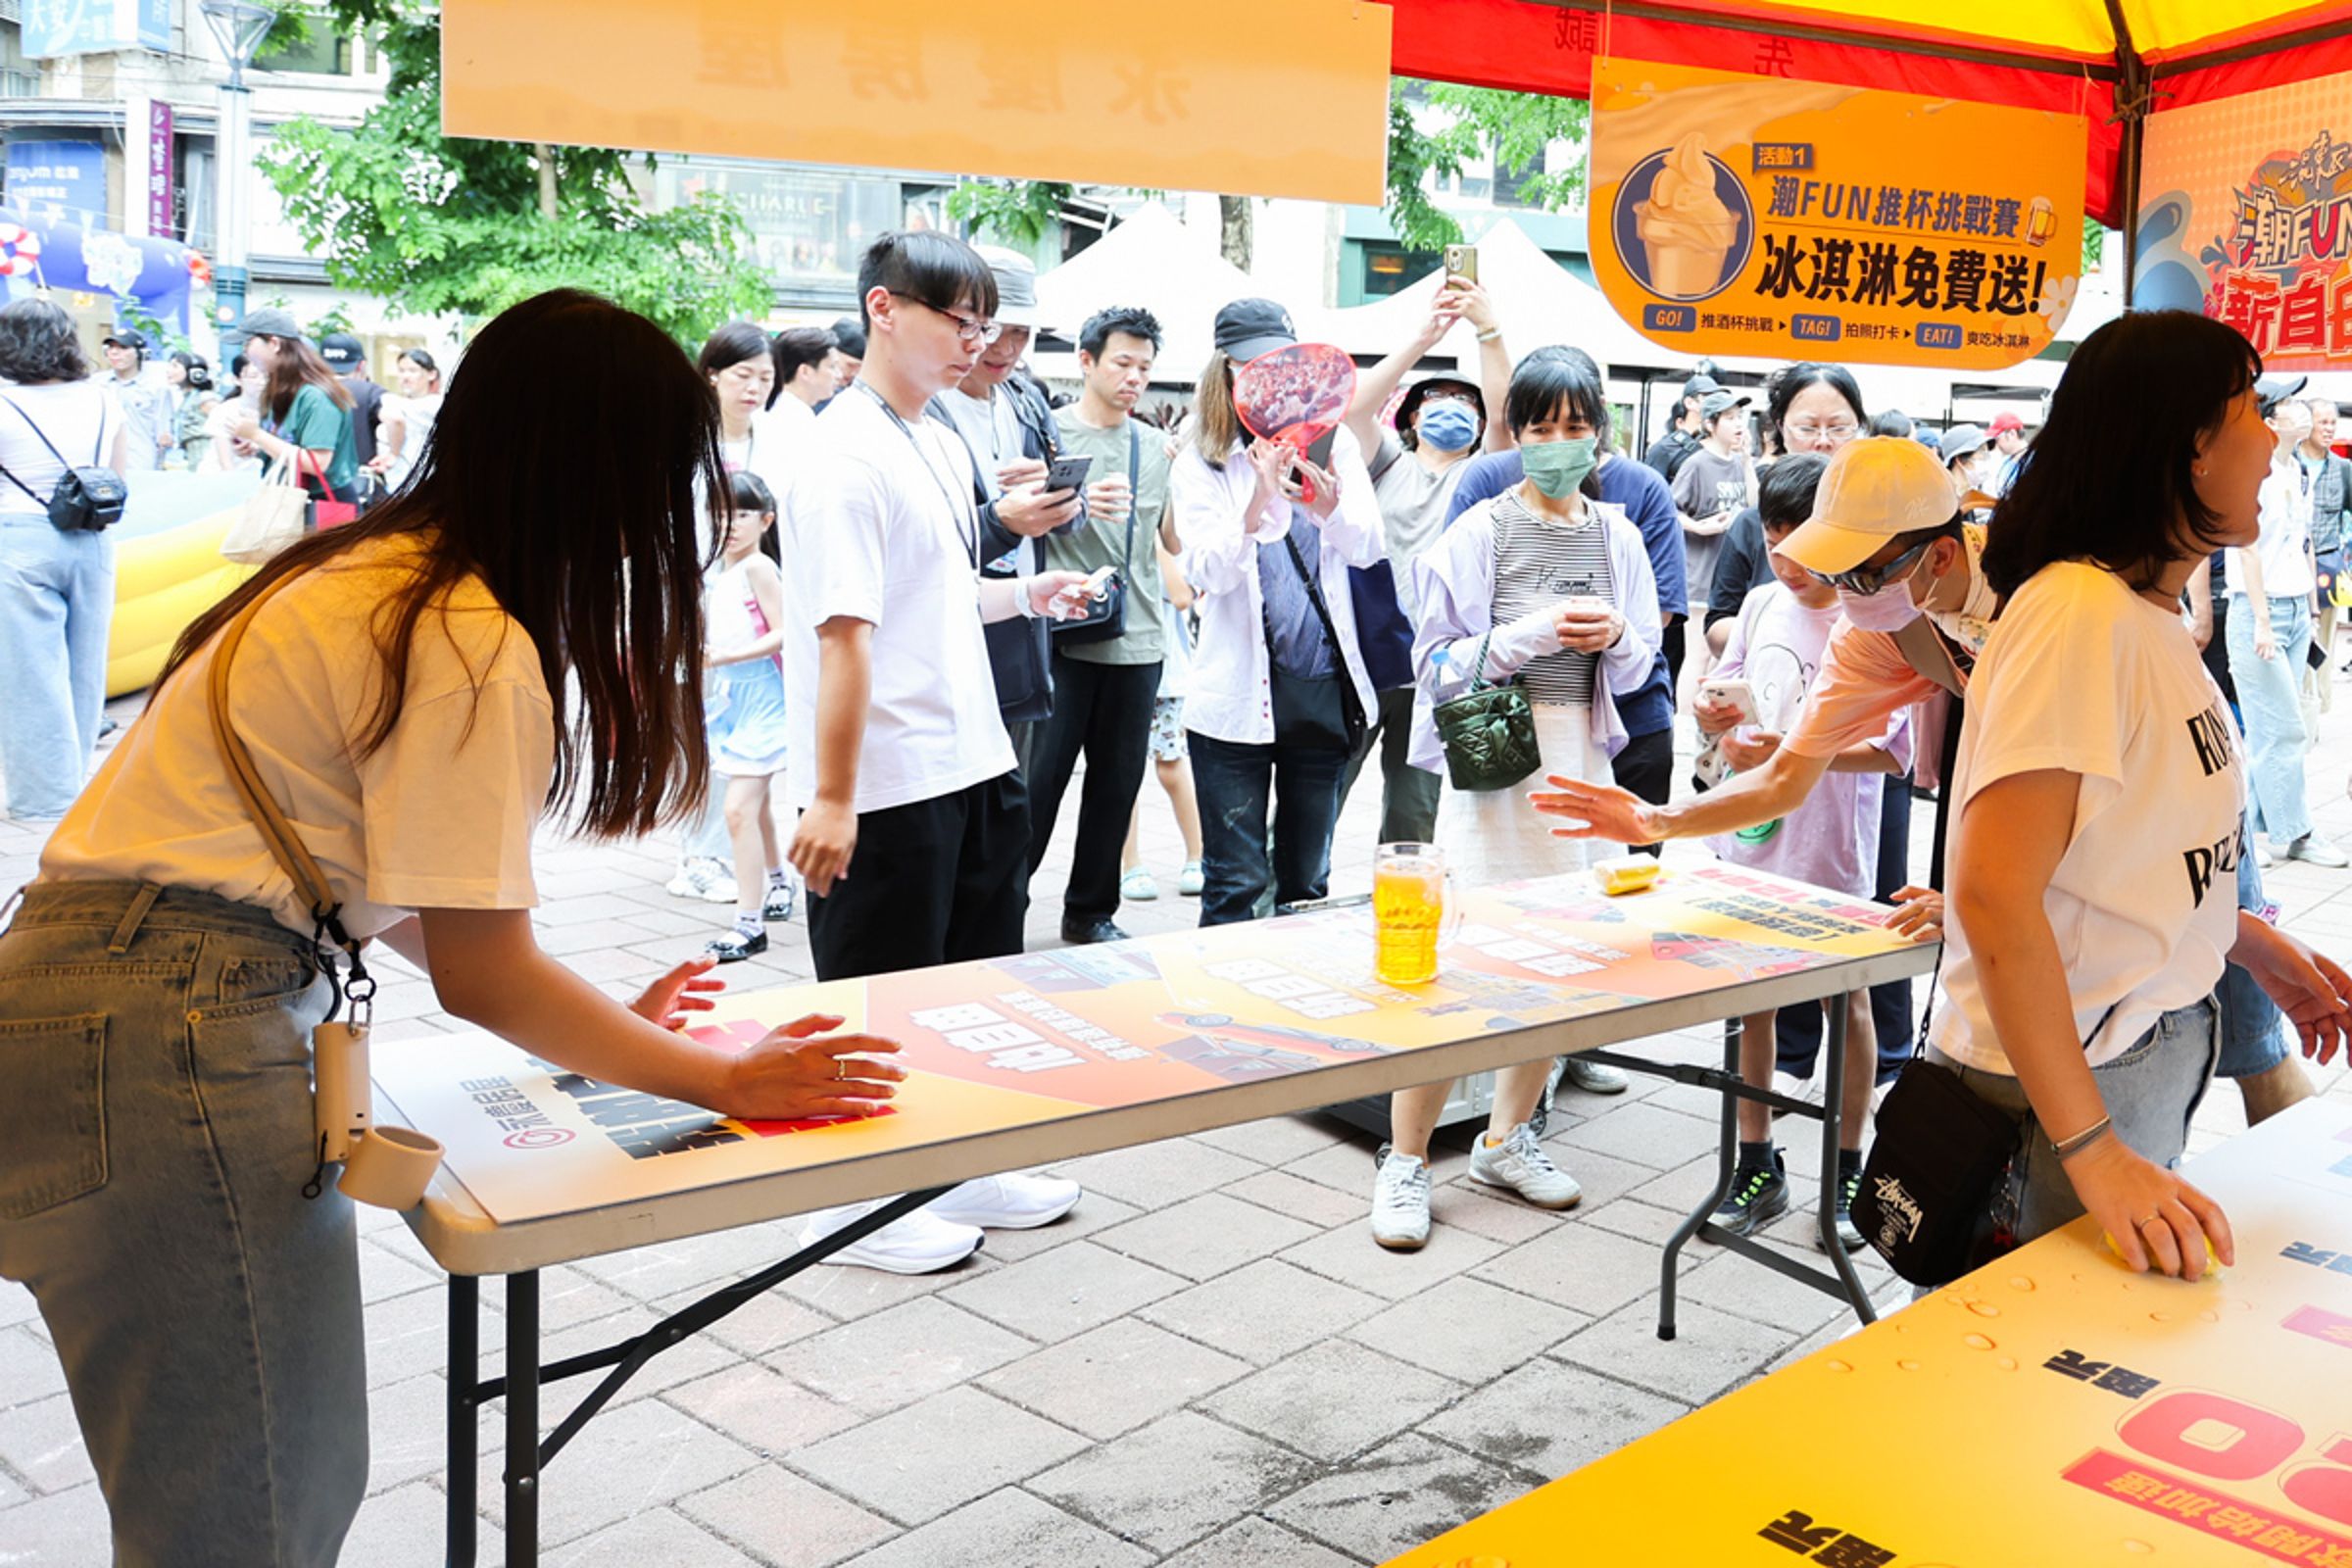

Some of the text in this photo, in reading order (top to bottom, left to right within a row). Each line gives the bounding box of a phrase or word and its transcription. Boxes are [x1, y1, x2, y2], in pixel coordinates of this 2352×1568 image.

[1757, 146, 1805, 167] 活動1
[1767, 174, 2022, 238] 潮FUN推杯挑戰賽
[1754, 234, 2047, 316] 冰淇淋免費送!
[1654, 309, 2032, 350] GO! 推酒杯挑戰 TAG! 拍照打卡 EAT! 爽吃冰淇淋
[459, 1075, 553, 1132] 永慶房屋
